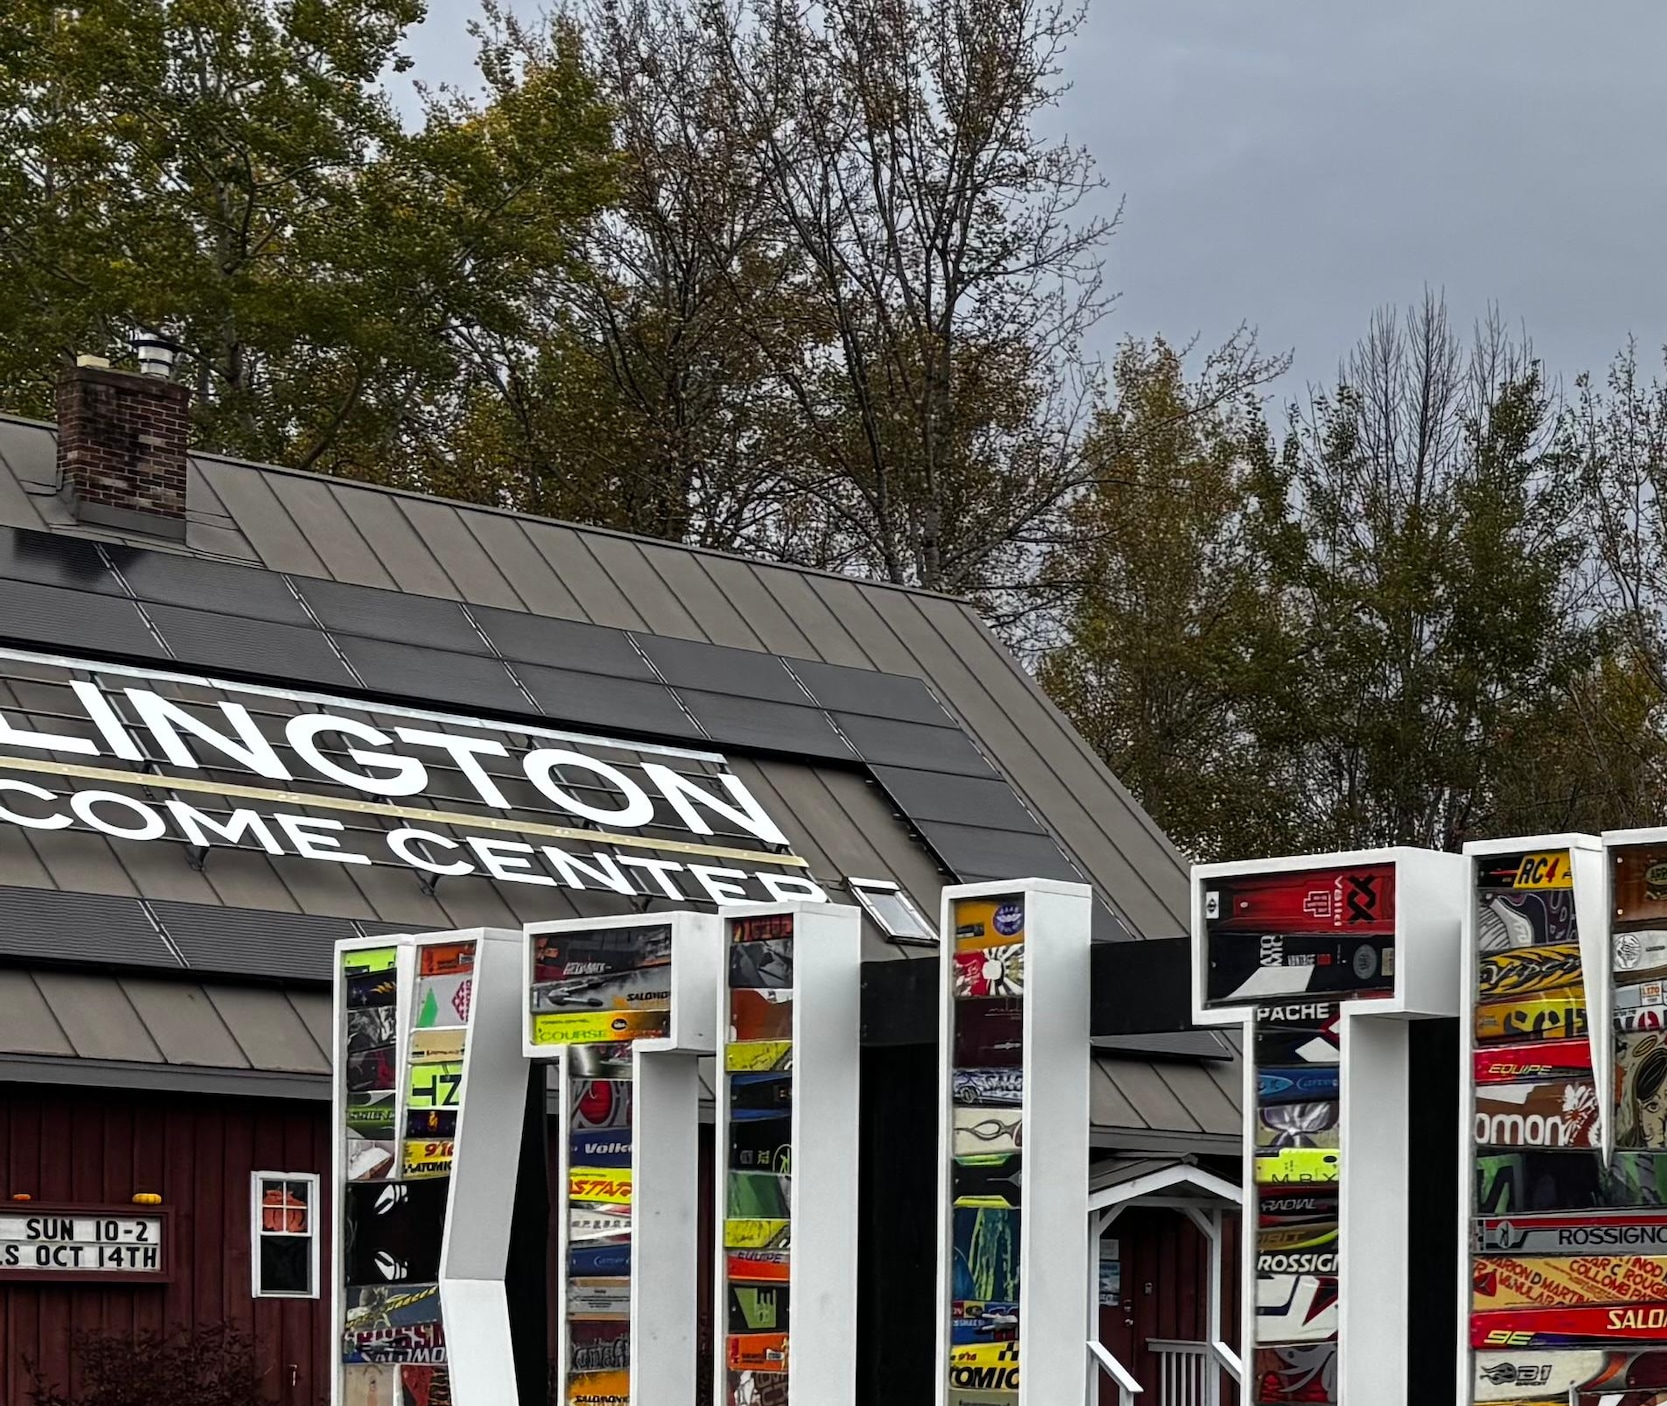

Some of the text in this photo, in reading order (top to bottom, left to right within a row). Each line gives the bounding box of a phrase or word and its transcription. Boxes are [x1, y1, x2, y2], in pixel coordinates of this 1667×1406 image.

[1517, 857, 1561, 889] RC4
[1256, 1002, 1331, 1022] PACHE
[1488, 1063, 1553, 1076] EQUIPE
[26, 1218, 148, 1242] SUN 10-2
[36, 1245, 84, 1267] OCT
[99, 1246, 157, 1268] 14TH
